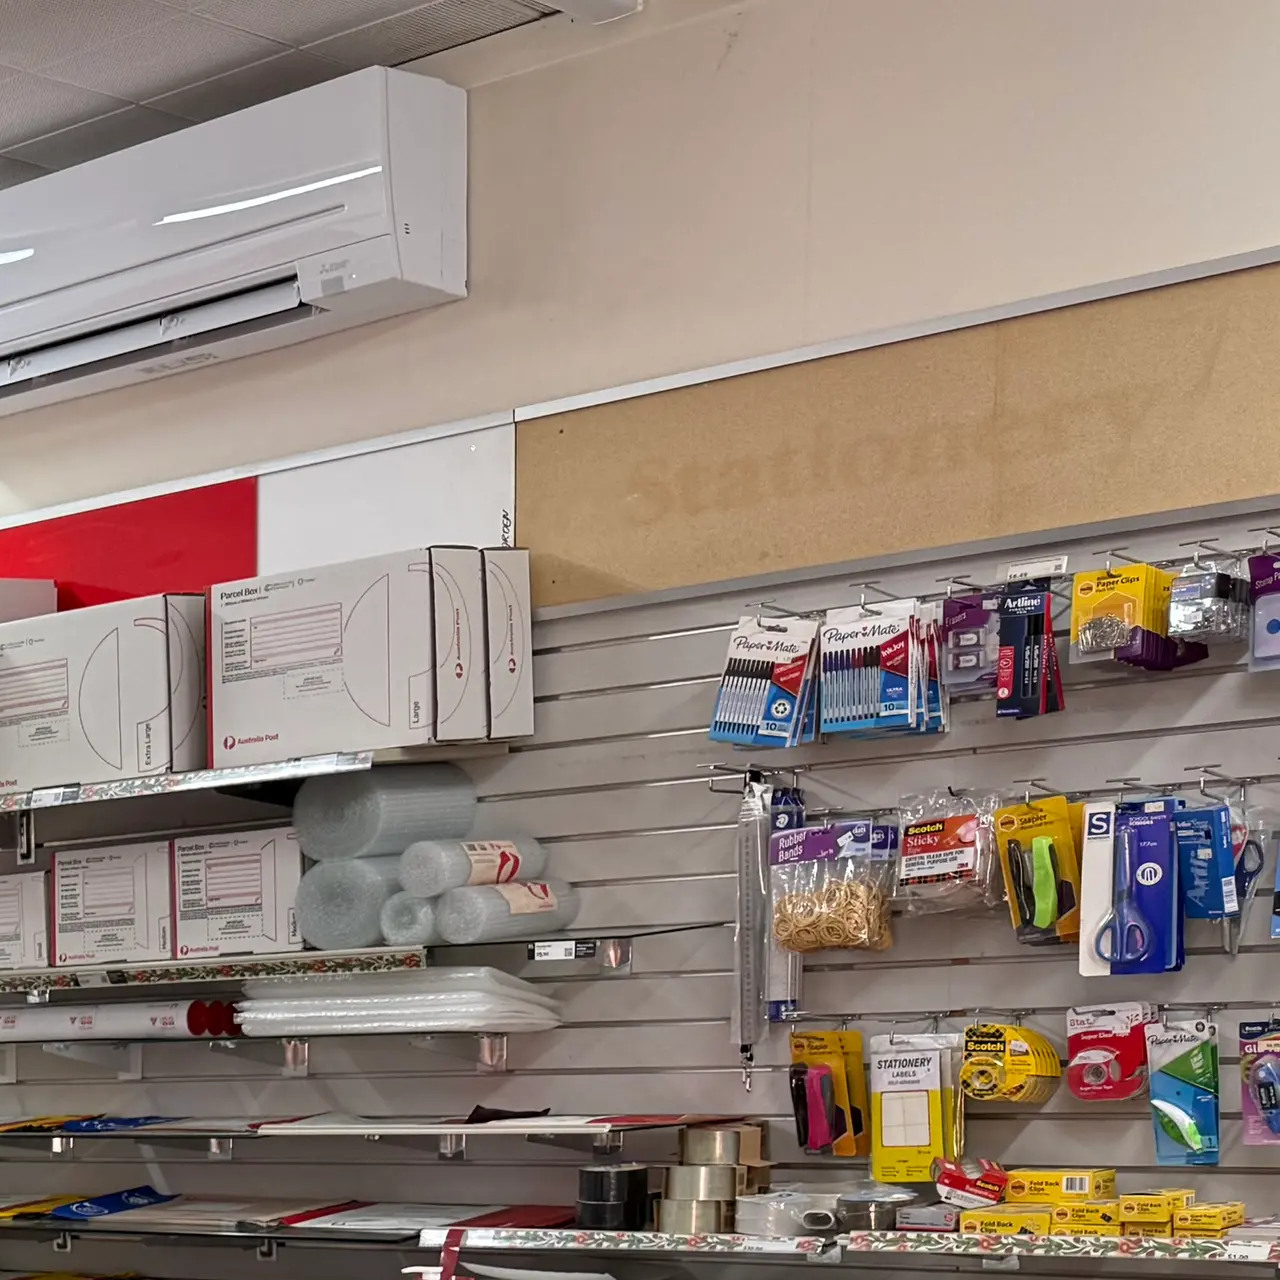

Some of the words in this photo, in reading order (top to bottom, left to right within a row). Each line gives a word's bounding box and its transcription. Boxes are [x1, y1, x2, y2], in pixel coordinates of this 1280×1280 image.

[1096, 579, 1119, 588] Paper
[1120, 575, 1140, 585] Clips
[220, 589, 242, 600] Parcel
[244, 587, 258, 596] Box
[1004, 596, 1040, 609] Artline
[945, 611, 967, 625] Erasers
[881, 641, 905, 657] InkJoy
[883, 703, 894, 711] 10
[144, 722, 153, 747] Large
[237, 735, 264, 745] Australia
[265, 733, 279, 741] Post
[144, 748, 152, 766] Extra
[1019, 814, 1048, 826] Stapler
[908, 822, 943, 835] Scotch
[779, 830, 806, 849] Rubber
[907, 834, 940, 848] Sticky
[779, 846, 803, 863] Bands
[967, 1041, 1004, 1052] Scotch
[877, 1057, 932, 1069] STATIONERY
[980, 1227, 996, 1235] Clips
